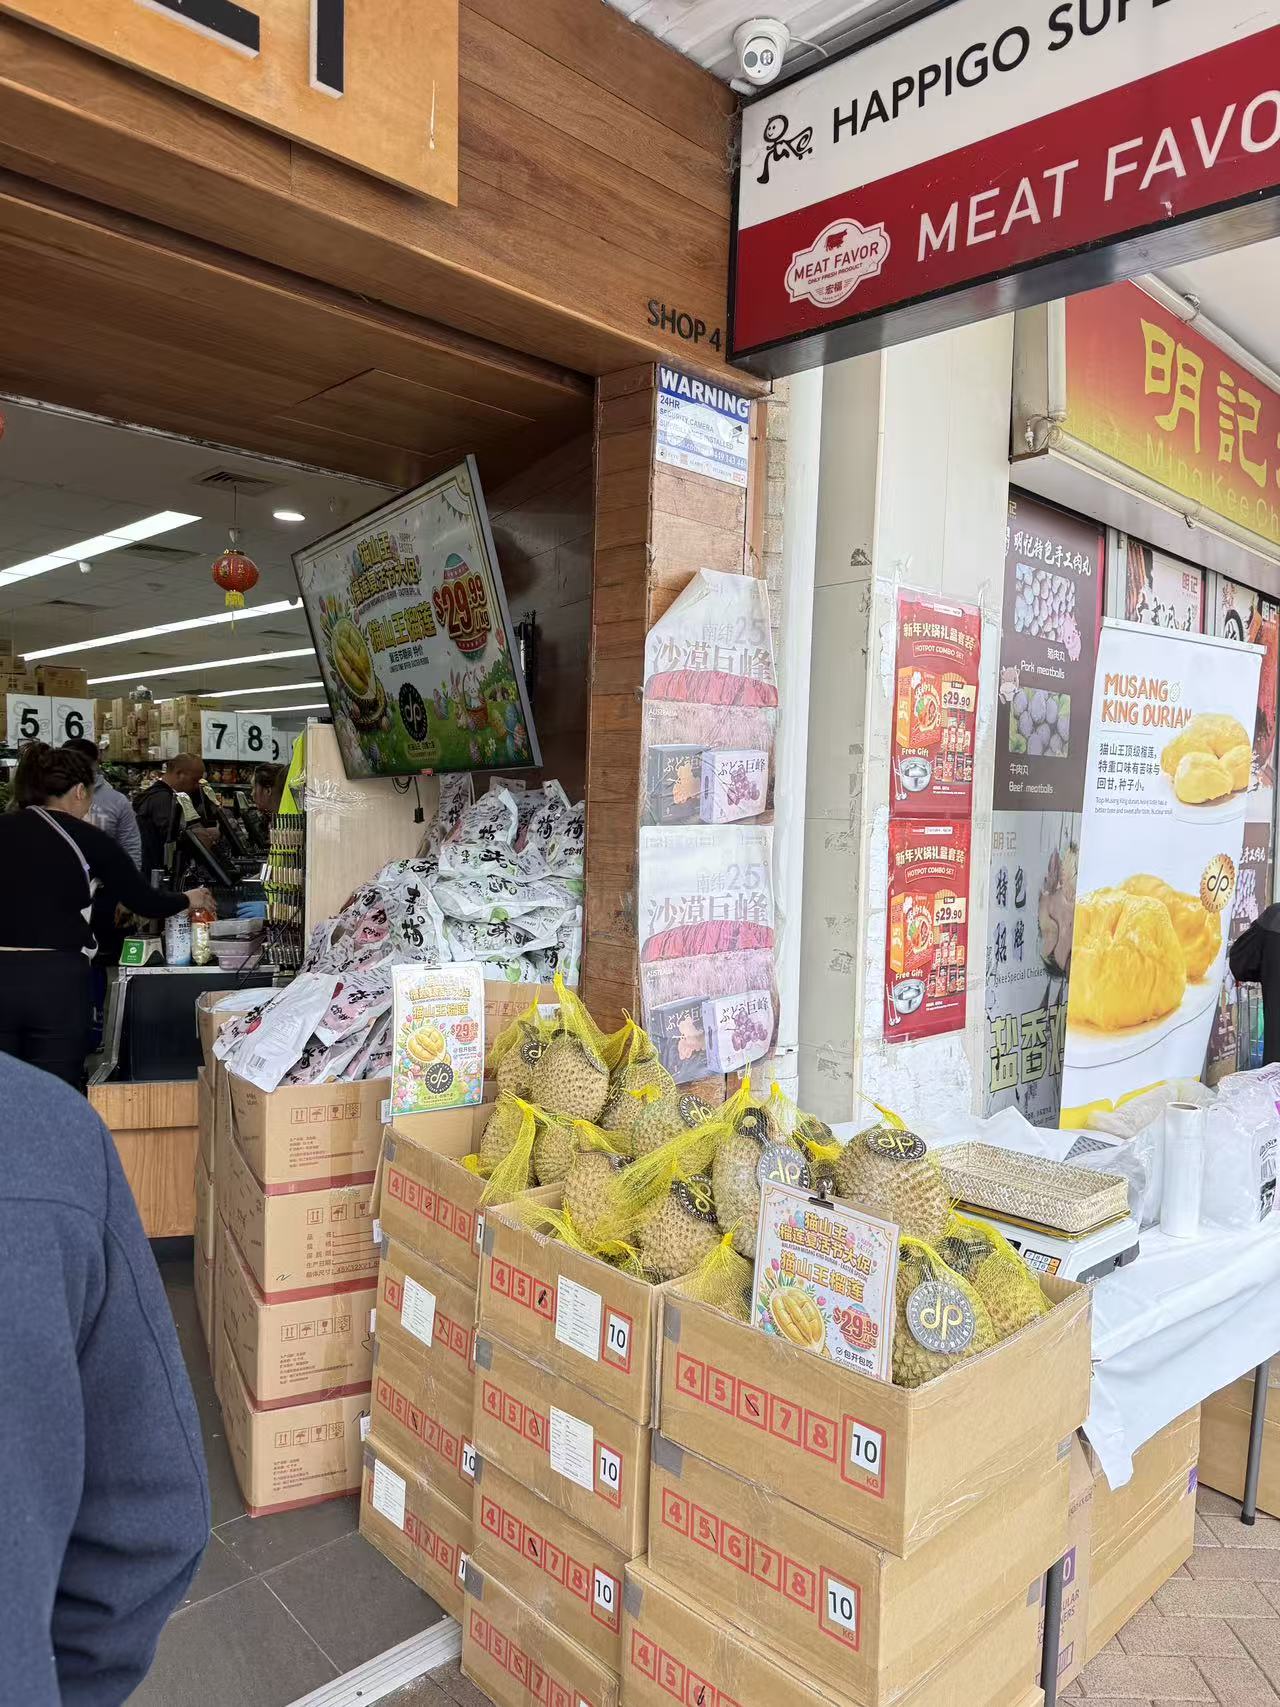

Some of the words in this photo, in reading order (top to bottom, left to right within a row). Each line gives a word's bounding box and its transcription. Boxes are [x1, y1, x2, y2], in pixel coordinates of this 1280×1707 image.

[833, 25, 1030, 144] HAPPIGO
[917, 160, 1079, 262] MEAT
[794, 257, 830, 282] MEAT
[834, 242, 879, 268] FAVOR
[647, 299, 706, 343] SHOP
[709, 328, 721, 352] 4
[660, 367, 751, 418] WARNING
[660, 395, 680, 409] 24HR
[1140, 317, 1280, 488] 明記
[1147, 434, 1203, 500] Ming
[1212, 471, 1249, 517] Kee
[432, 574, 487, 640] $29.99
[652, 635, 772, 681] 沙漠巨峰
[1021, 660, 1036, 672] Pork
[1037, 665, 1065, 680] meatballs
[943, 691, 971, 707] $29.90
[1103, 672, 1169, 702] MUSANG
[20, 708, 39, 738] 5
[65, 711, 84, 740] 6
[1101, 699, 1139, 725] KING
[1142, 704, 1192, 729] DURIAN
[212, 723, 228, 749] 7
[247, 725, 263, 752] 8
[901, 747, 917, 756] Free
[917, 747, 929, 757] Gift
[1009, 781, 1024, 794] Beef
[1026, 783, 1053, 795] meatballs
[907, 867, 926, 877] HOTPOT
[928, 867, 944, 876] COMBO
[945, 867, 954, 876] SET
[648, 893, 768, 933] 沙漠巨峰
[936, 906, 962, 921] $29.90
[896, 971, 910, 980] Free
[911, 969, 924, 978] Gift
[430, 1067, 449, 1088] dp
[877, 1133, 914, 1155] dp
[392, 1178, 400, 1192] 4
[408, 1186, 415, 1202] 5
[442, 1204, 449, 1220] 7
[459, 1216, 466, 1232] 8
[804, 1210, 848, 1243] 猫山王
[779, 1223, 872, 1276] 榴莲复活节大促
[780, 1249, 865, 1303] 猫山王榴莲
[388, 1286, 396, 1302] 4
[456, 1330, 464, 1347] 8
[496, 1268, 506, 1286] 4
[518, 1280, 526, 1298] 5
[609, 1323, 626, 1349] 10
[832, 1305, 879, 1339] $29.99
[920, 1295, 963, 1341] dp
[843, 1349, 874, 1370] 包开包吃
[380, 1387, 388, 1404] 4
[395, 1398, 403, 1414] 5
[428, 1424, 436, 1441] 7
[446, 1439, 454, 1456] 8
[684, 1368, 697, 1388] 4
[714, 1378, 726, 1402] 5
[778, 1406, 792, 1432] 7
[812, 1424, 828, 1450] 8
[853, 1433, 878, 1464] 10
[488, 1392, 496, 1410] 4
[508, 1406, 516, 1423] 5
[601, 1456, 618, 1482] 10
[866, 1475, 880, 1489] KG
[440, 1546, 449, 1564] 8
[486, 1508, 496, 1526] 4
[508, 1521, 515, 1540] 5
[550, 1551, 558, 1572] 7
[573, 1568, 583, 1588] 8
[595, 1579, 612, 1604] 10
[668, 1501, 682, 1524] 4
[699, 1516, 711, 1540] 5
[728, 1535, 742, 1559] 6
[760, 1550, 772, 1576] 7
[792, 1572, 806, 1598] 8
[828, 1590, 853, 1620] 10
[474, 1621, 484, 1640] 4
[494, 1638, 502, 1656] 5
[536, 1667, 544, 1688] 7
[842, 1628, 854, 1642] KG
[637, 1645, 650, 1668] 4
[666, 1665, 676, 1687] 5
